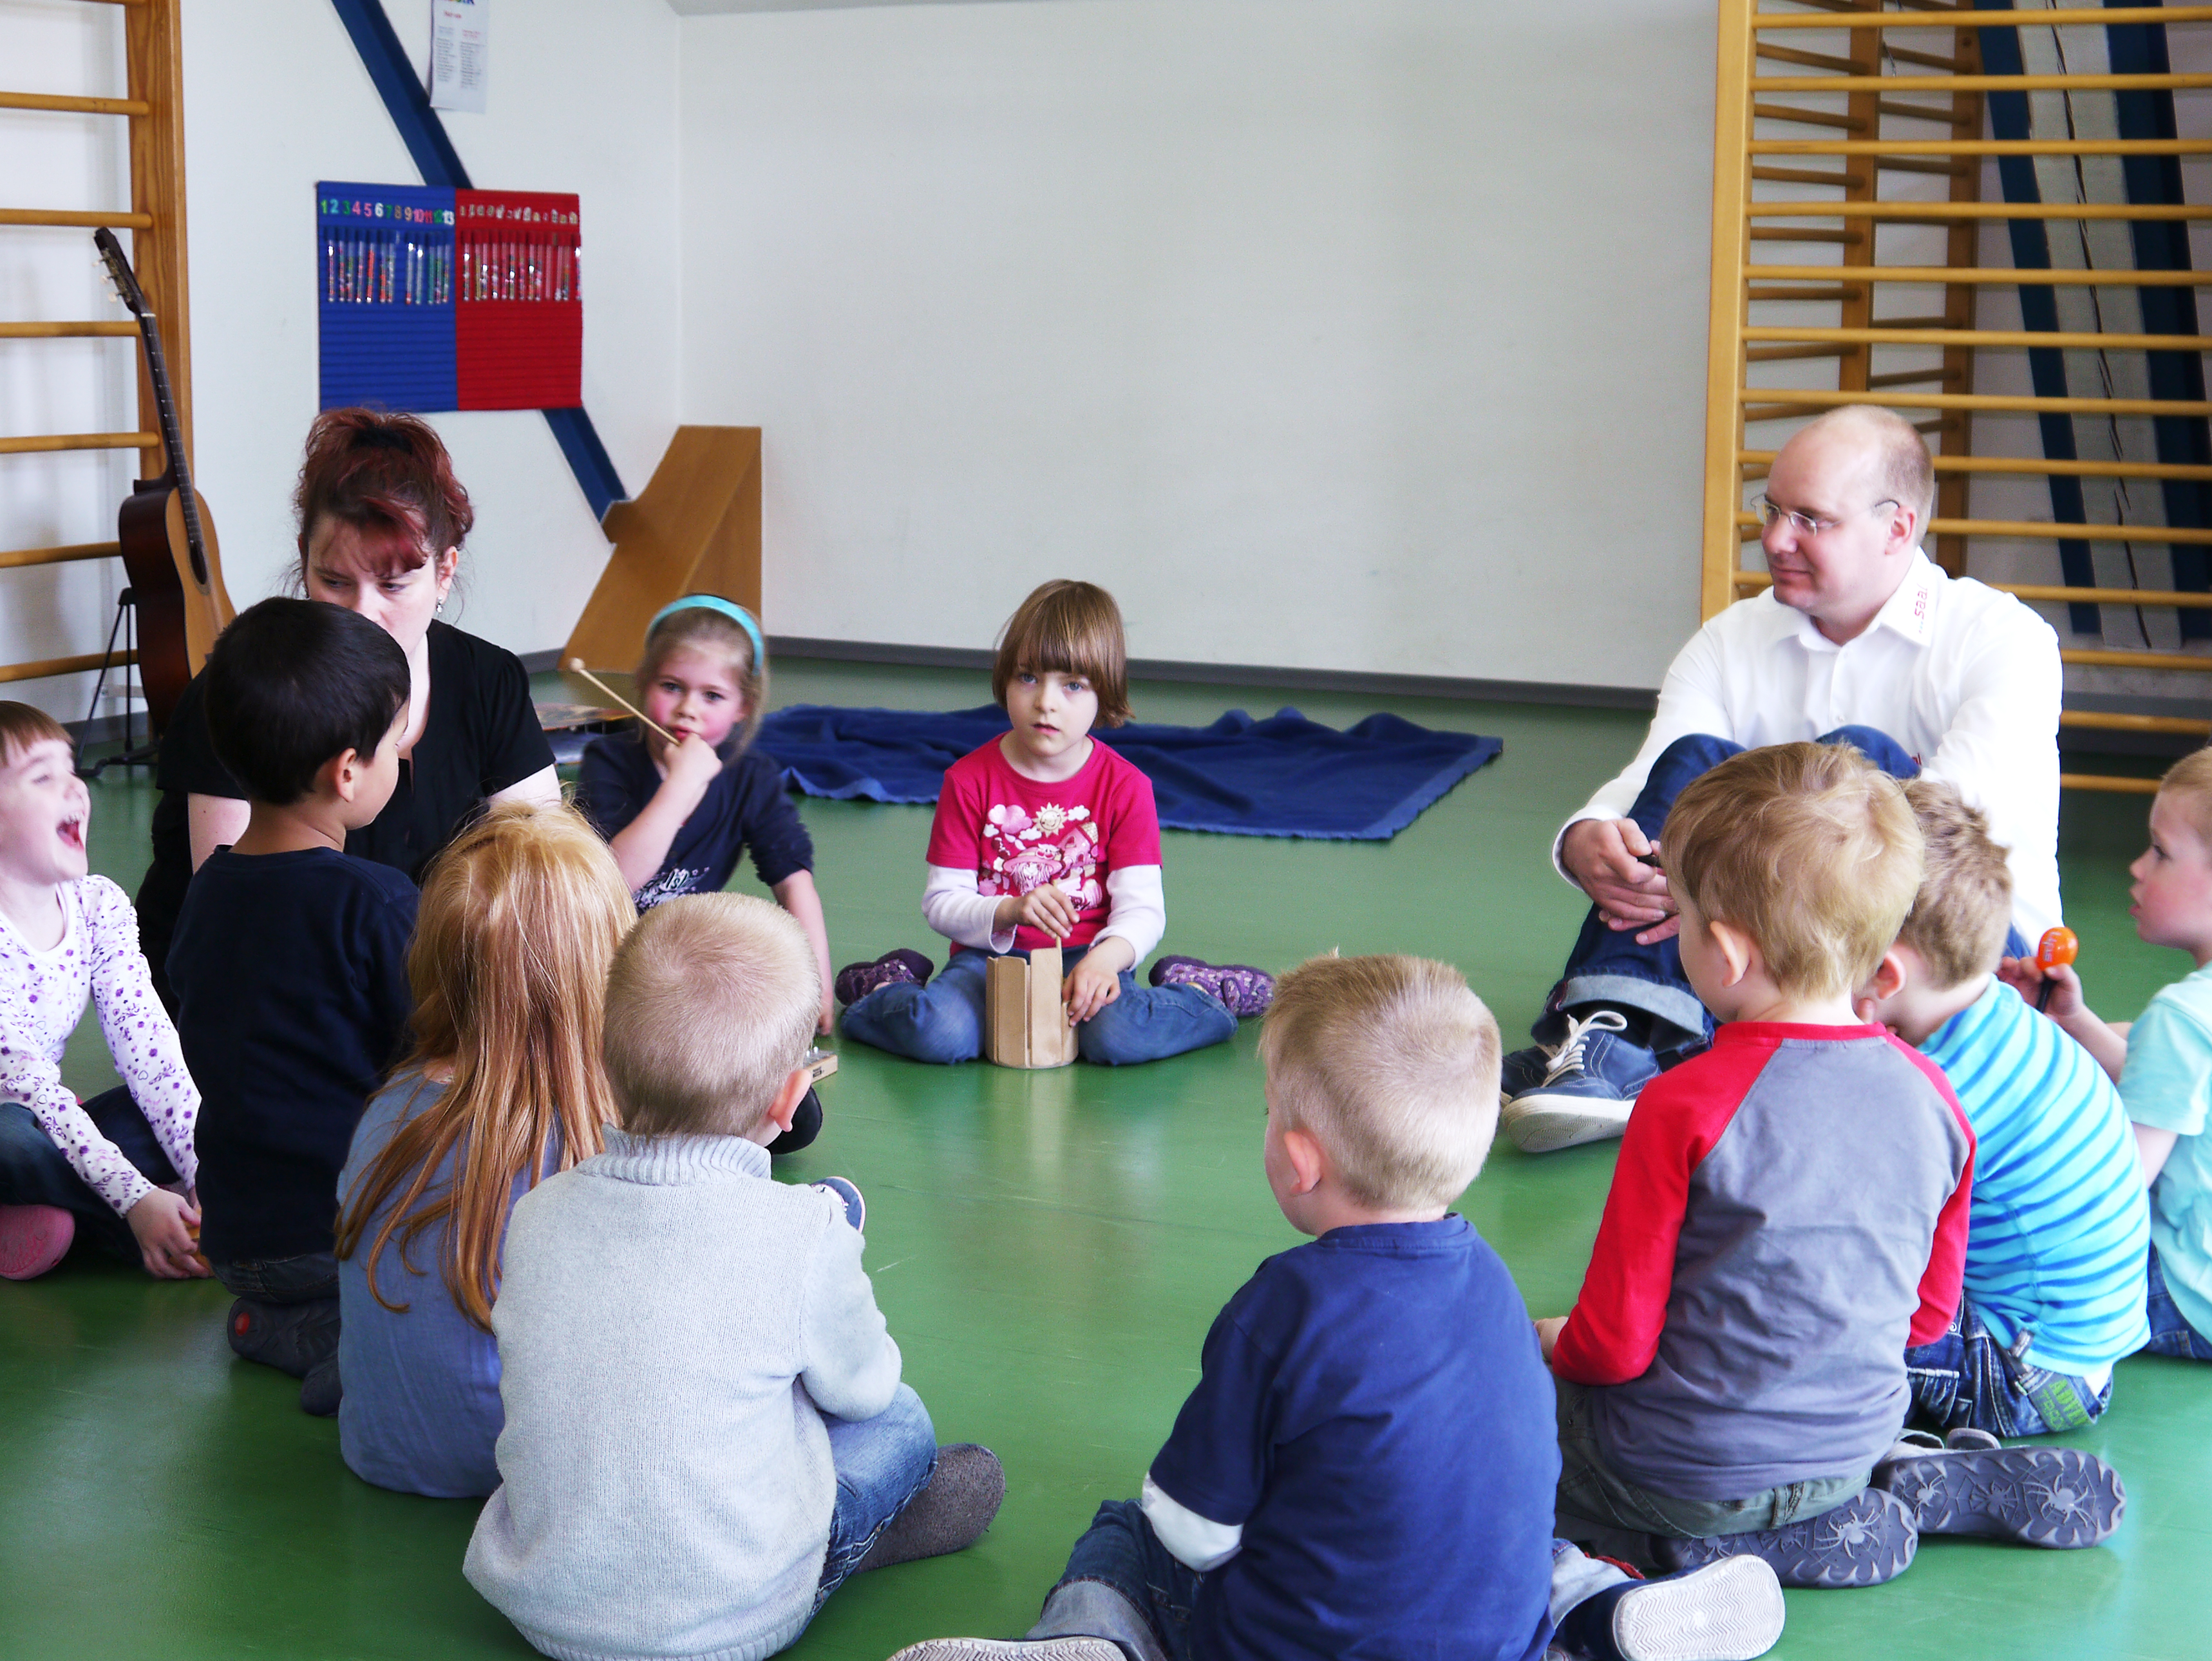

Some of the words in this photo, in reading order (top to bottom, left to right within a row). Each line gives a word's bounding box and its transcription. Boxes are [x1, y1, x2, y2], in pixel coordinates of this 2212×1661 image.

[321, 199, 327, 214] 1
[330, 198, 338, 214] 2
[343, 200, 350, 214] 3
[352, 200, 361, 215] 4
[364, 203, 372, 217] 5
[375, 202, 383, 217] 6
[386, 204, 393, 218] 7
[395, 205, 402, 220] 8
[404, 207, 412, 221] 9
[413, 209, 424, 223] 10
[442, 209, 455, 225] 13
